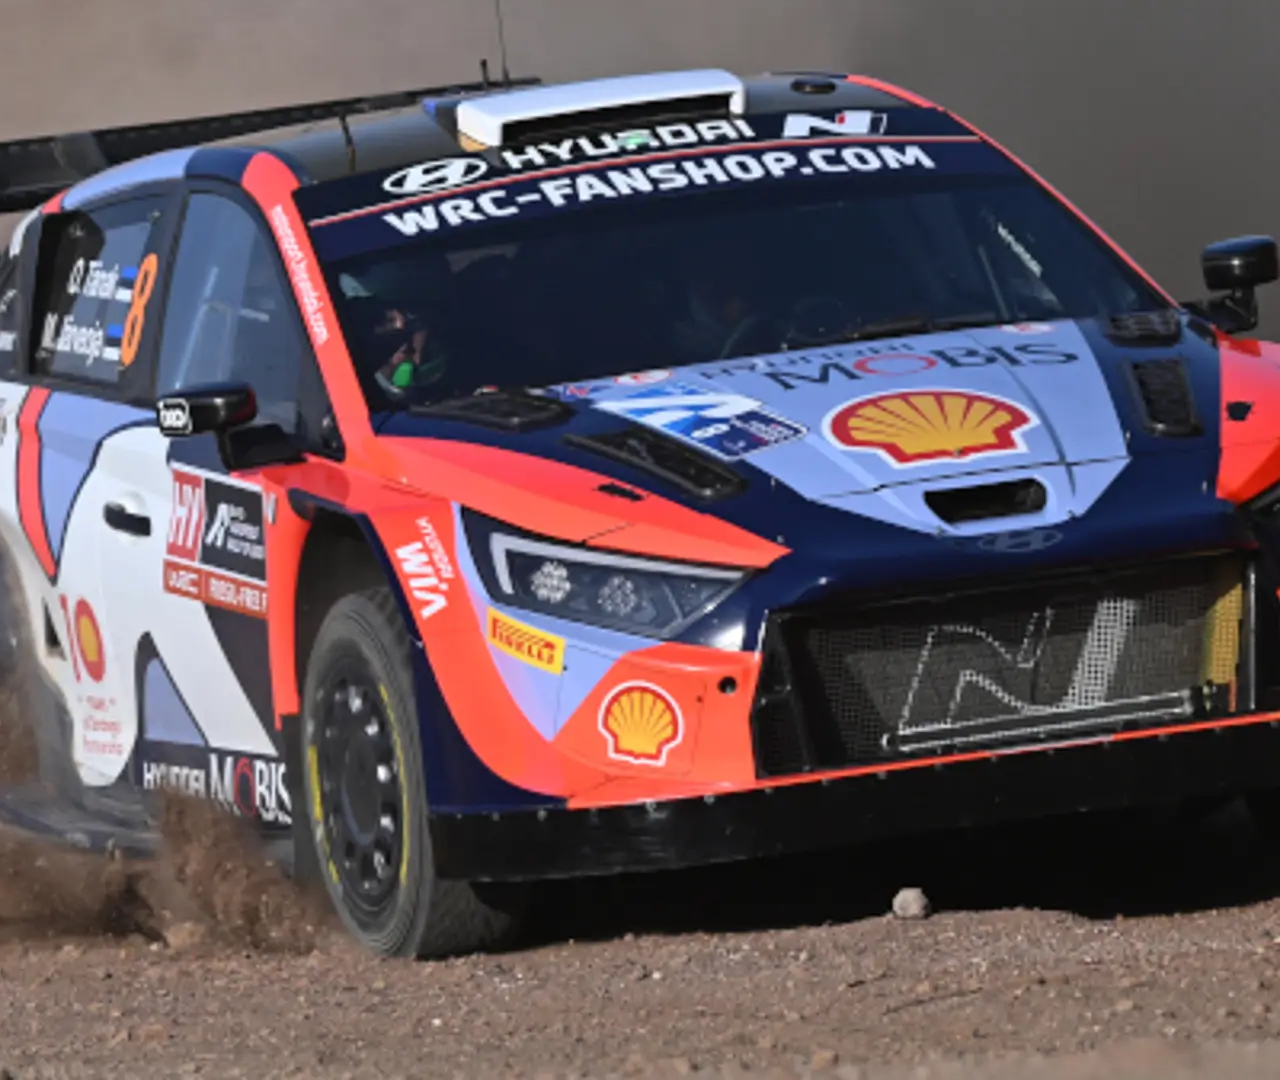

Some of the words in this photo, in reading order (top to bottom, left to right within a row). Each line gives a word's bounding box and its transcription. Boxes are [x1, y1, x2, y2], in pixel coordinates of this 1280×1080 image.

[501, 117, 756, 170] HYUNDAI
[382, 145, 936, 237] WRC-FANSHOP.COM
[121, 252, 159, 367] 8
[764, 343, 1080, 391] MOBIS
[395, 541, 449, 620] WIA
[490, 615, 558, 666] PIRELLI
